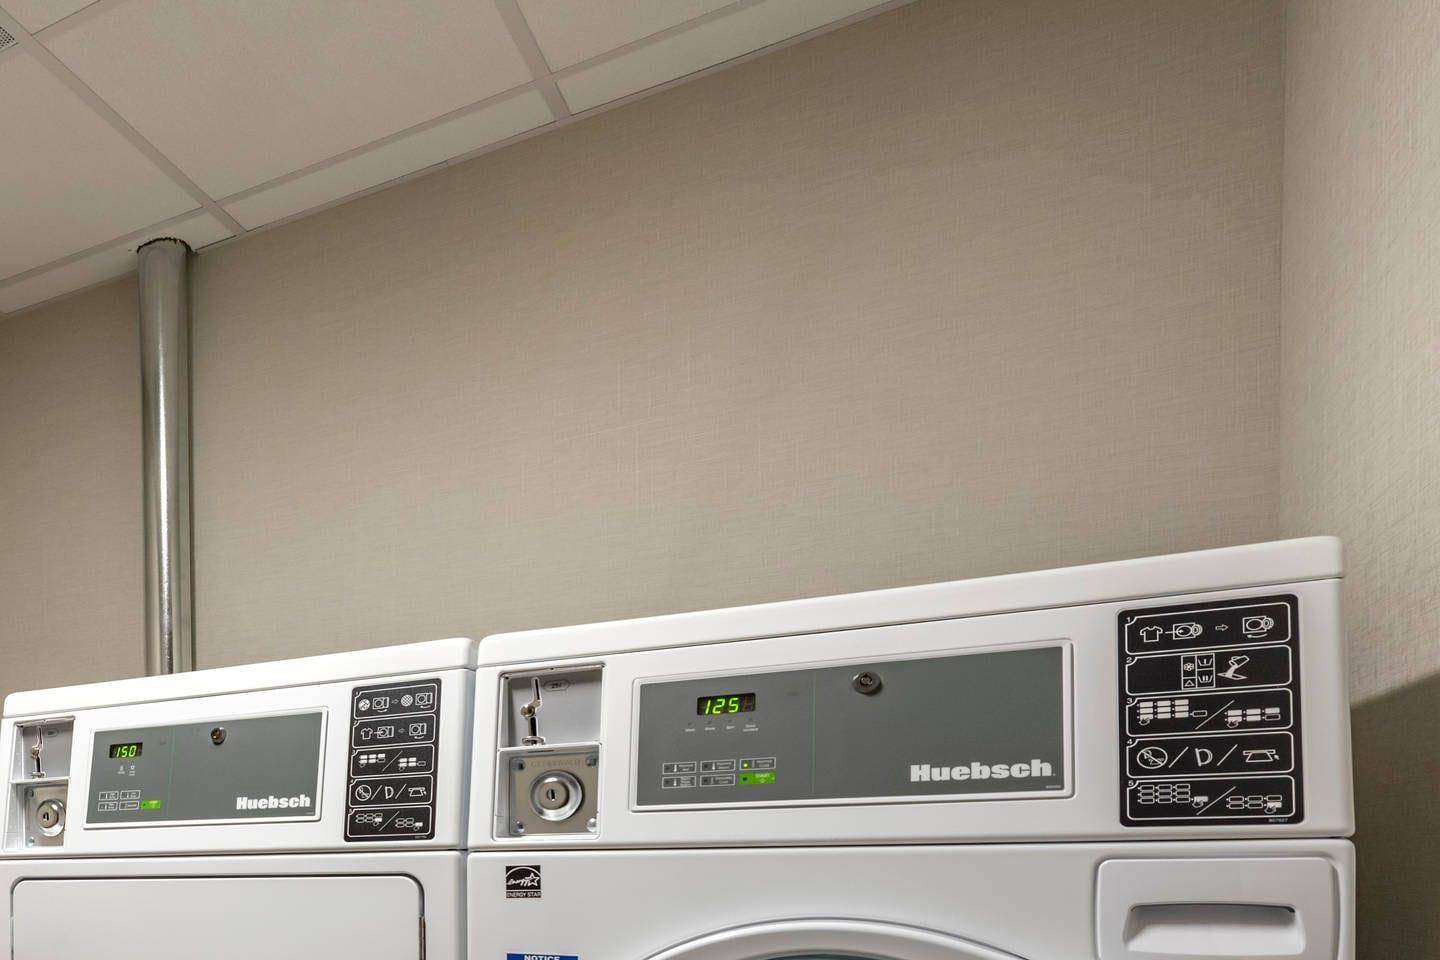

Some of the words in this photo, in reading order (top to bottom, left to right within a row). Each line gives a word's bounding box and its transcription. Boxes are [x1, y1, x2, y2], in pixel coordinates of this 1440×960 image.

[705, 697, 739, 714] 125
[116, 745, 137, 758] 150
[910, 759, 1052, 782] Huebsch
[236, 794, 311, 810] Huebsch
